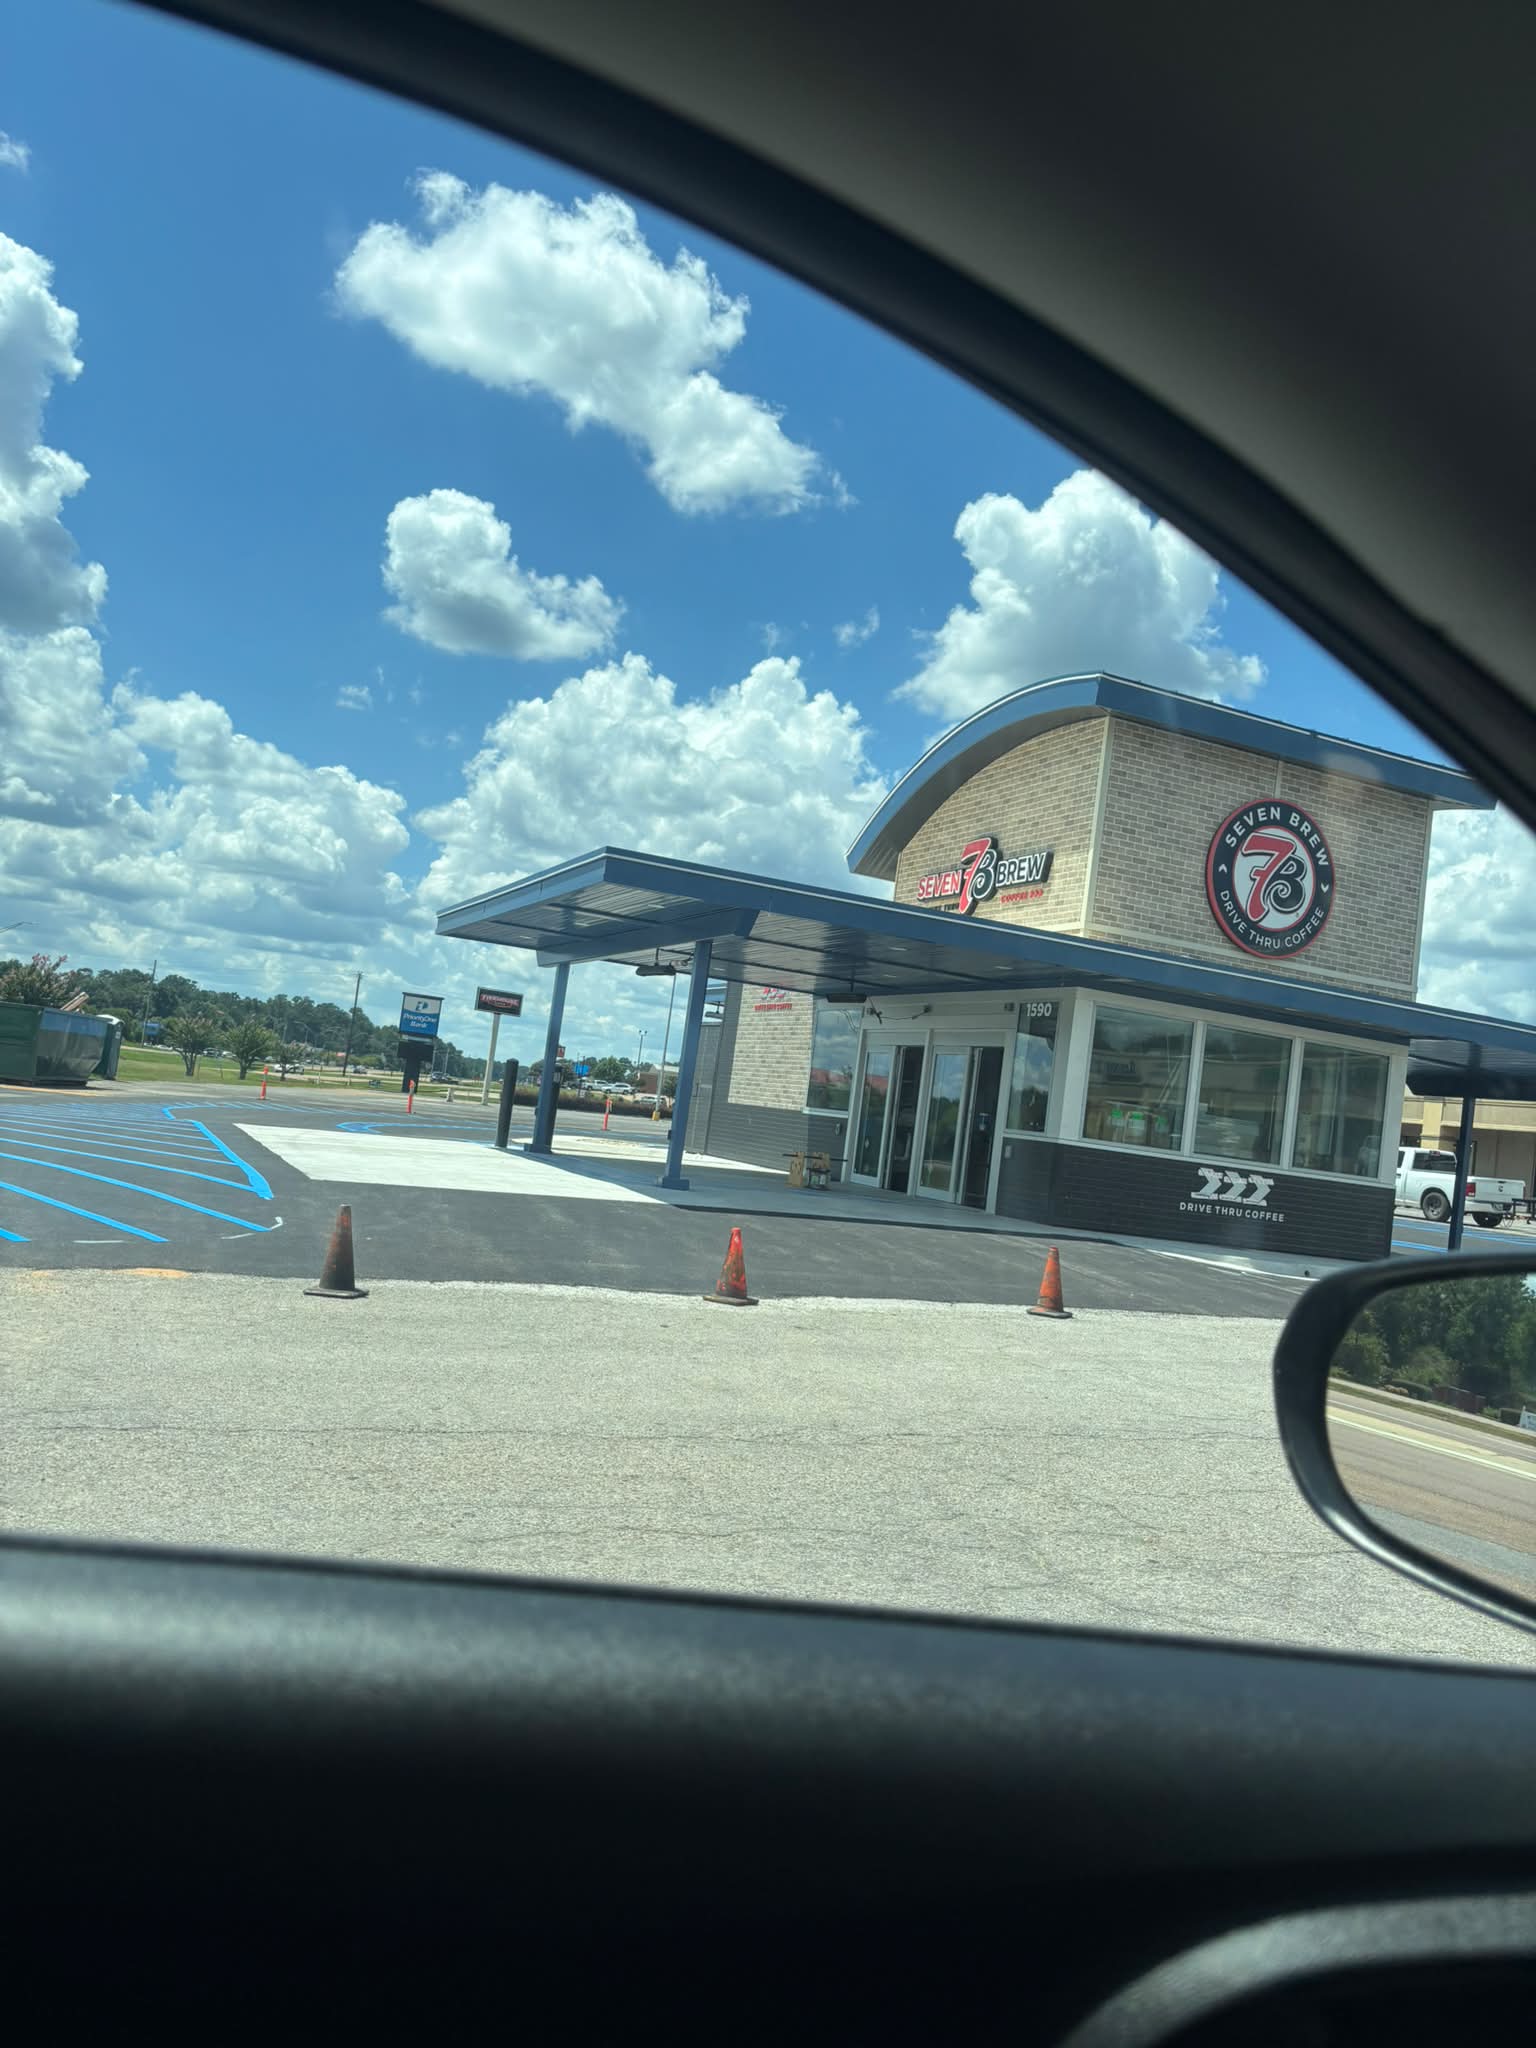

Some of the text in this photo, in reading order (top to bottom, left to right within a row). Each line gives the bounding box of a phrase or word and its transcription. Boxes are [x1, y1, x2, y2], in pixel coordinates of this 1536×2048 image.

[1225, 806, 1329, 866] SEVEN BREW
[917, 869, 961, 899] SEVEN
[995, 852, 1047, 888] BREW
[1220, 890, 1325, 949] DRIVE THRU COFFEE
[1026, 1002, 1052, 1017] 1590
[1179, 1202, 1285, 1222] DRIVE THRU COFFEE
